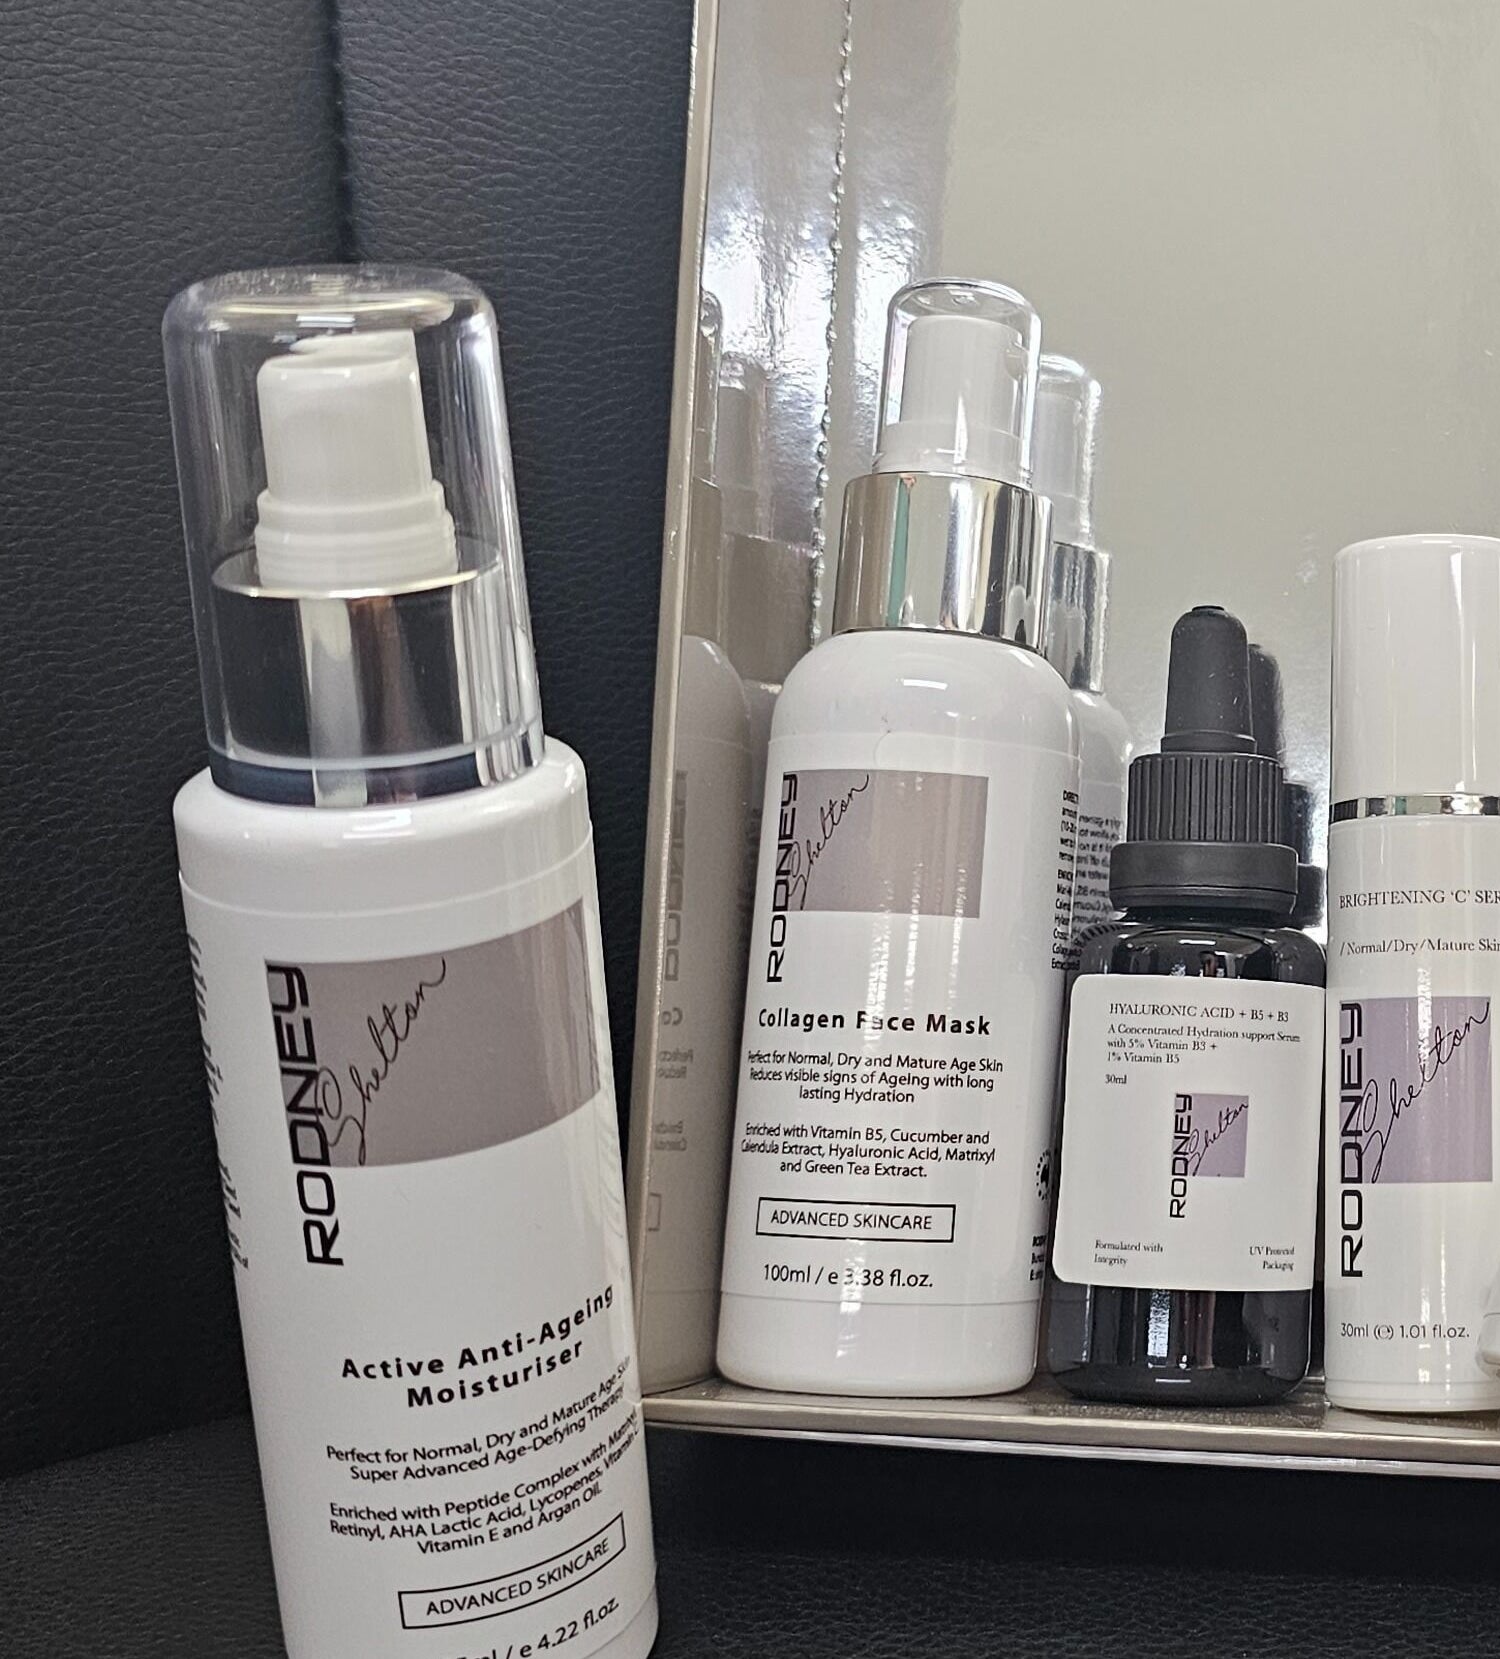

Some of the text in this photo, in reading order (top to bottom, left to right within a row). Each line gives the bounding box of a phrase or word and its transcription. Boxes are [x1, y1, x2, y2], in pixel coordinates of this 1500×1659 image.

[788, 774, 869, 911] Shelton
[767, 773, 798, 982] RODNEY
[1339, 890, 1445, 909] BRIGHTENING
[759, 1008, 844, 1032] Collagen
[926, 1014, 990, 1035] Mask
[1110, 1003, 1197, 1016] HYALURONIC
[1200, 1007, 1234, 1018] ACID
[1187, 1026, 1238, 1039] Hydration
[315, 957, 446, 1166] Shelton
[838, 1053, 862, 1069] Dry
[896, 1055, 947, 1070] Mature
[950, 1058, 976, 1074] Age
[979, 1058, 1002, 1072] Skin
[800, 1085, 914, 1104] lasting Hydration
[823, 1070, 857, 1086] signs
[878, 1072, 929, 1089] Ageing
[967, 1075, 993, 1092] long
[1356, 1001, 1490, 1183] Shelton
[266, 964, 343, 1265] RODNEY
[811, 1126, 861, 1140] Vitamin
[891, 1129, 963, 1143] Cucumber
[1188, 1103, 1248, 1176] Shelton
[1340, 1003, 1363, 1277] RODNEY
[805, 1160, 843, 1174] Green
[847, 1162, 870, 1175] Tea
[829, 1143, 904, 1160] Hyaluronic
[945, 1148, 995, 1165] Matrixyl
[1170, 1093, 1193, 1218] RODNEY
[771, 1210, 932, 1229] ADVANCED SKINCARE
[765, 1264, 810, 1283] 100ml
[342, 1358, 444, 1379] Active
[458, 1286, 612, 1369] Anti-Ageing
[1341, 1323, 1368, 1337] 30ml
[1400, 1325, 1426, 1338] 1.01
[408, 1341, 582, 1407] Moisturiser
[327, 1446, 381, 1463] Perfect
[486, 1431, 515, 1448] Dry
[350, 1417, 585, 1483] Super Advanced Age-Defying
[330, 1462, 579, 1521] Enriched Peptide Complex
[390, 1524, 427, 1538] AHA
[431, 1517, 482, 1535] Lactic
[417, 1534, 484, 1554] Vitamin
[538, 1498, 580, 1526] Argan
[427, 1538, 608, 1615] ADVANCED SKINCARE
[538, 1621, 578, 1649] 4.22
